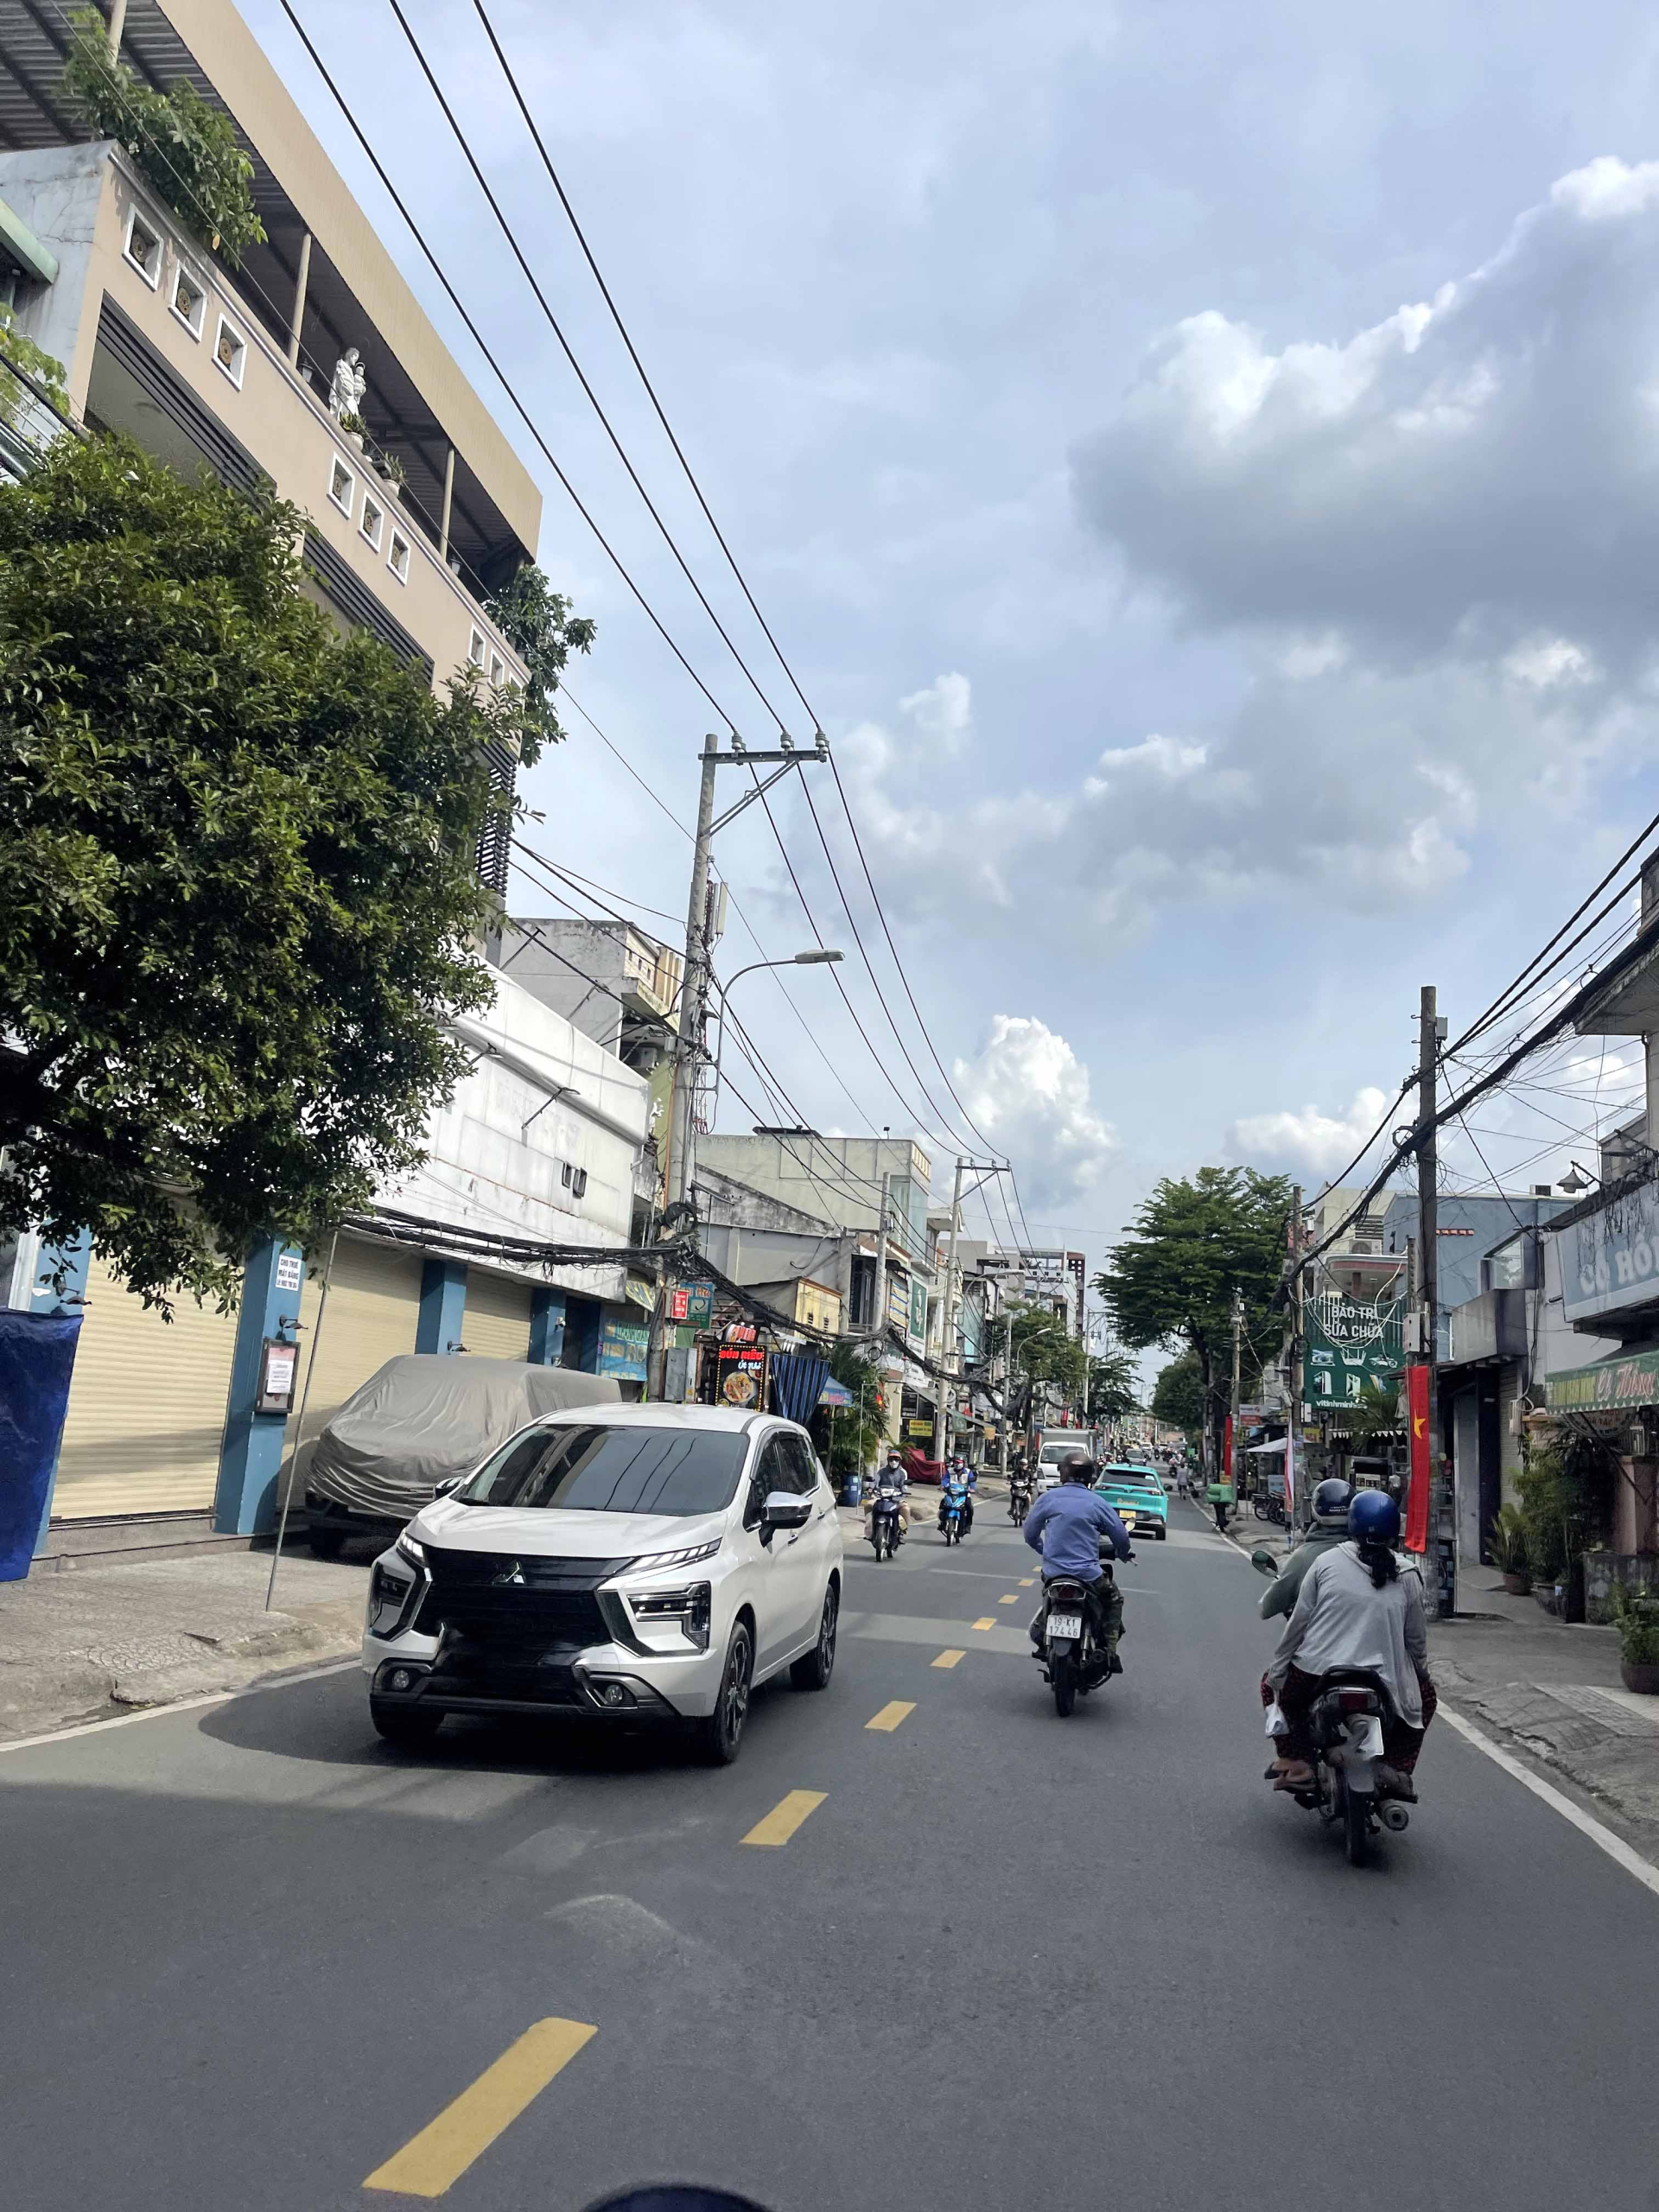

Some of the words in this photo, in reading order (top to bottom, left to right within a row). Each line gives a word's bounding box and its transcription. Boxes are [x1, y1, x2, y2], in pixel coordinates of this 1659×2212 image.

[1332, 1302, 1355, 1319] BẢO
[1324, 1320, 1349, 1337] SỬA
[1351, 1322, 1384, 1338] CHỮA
